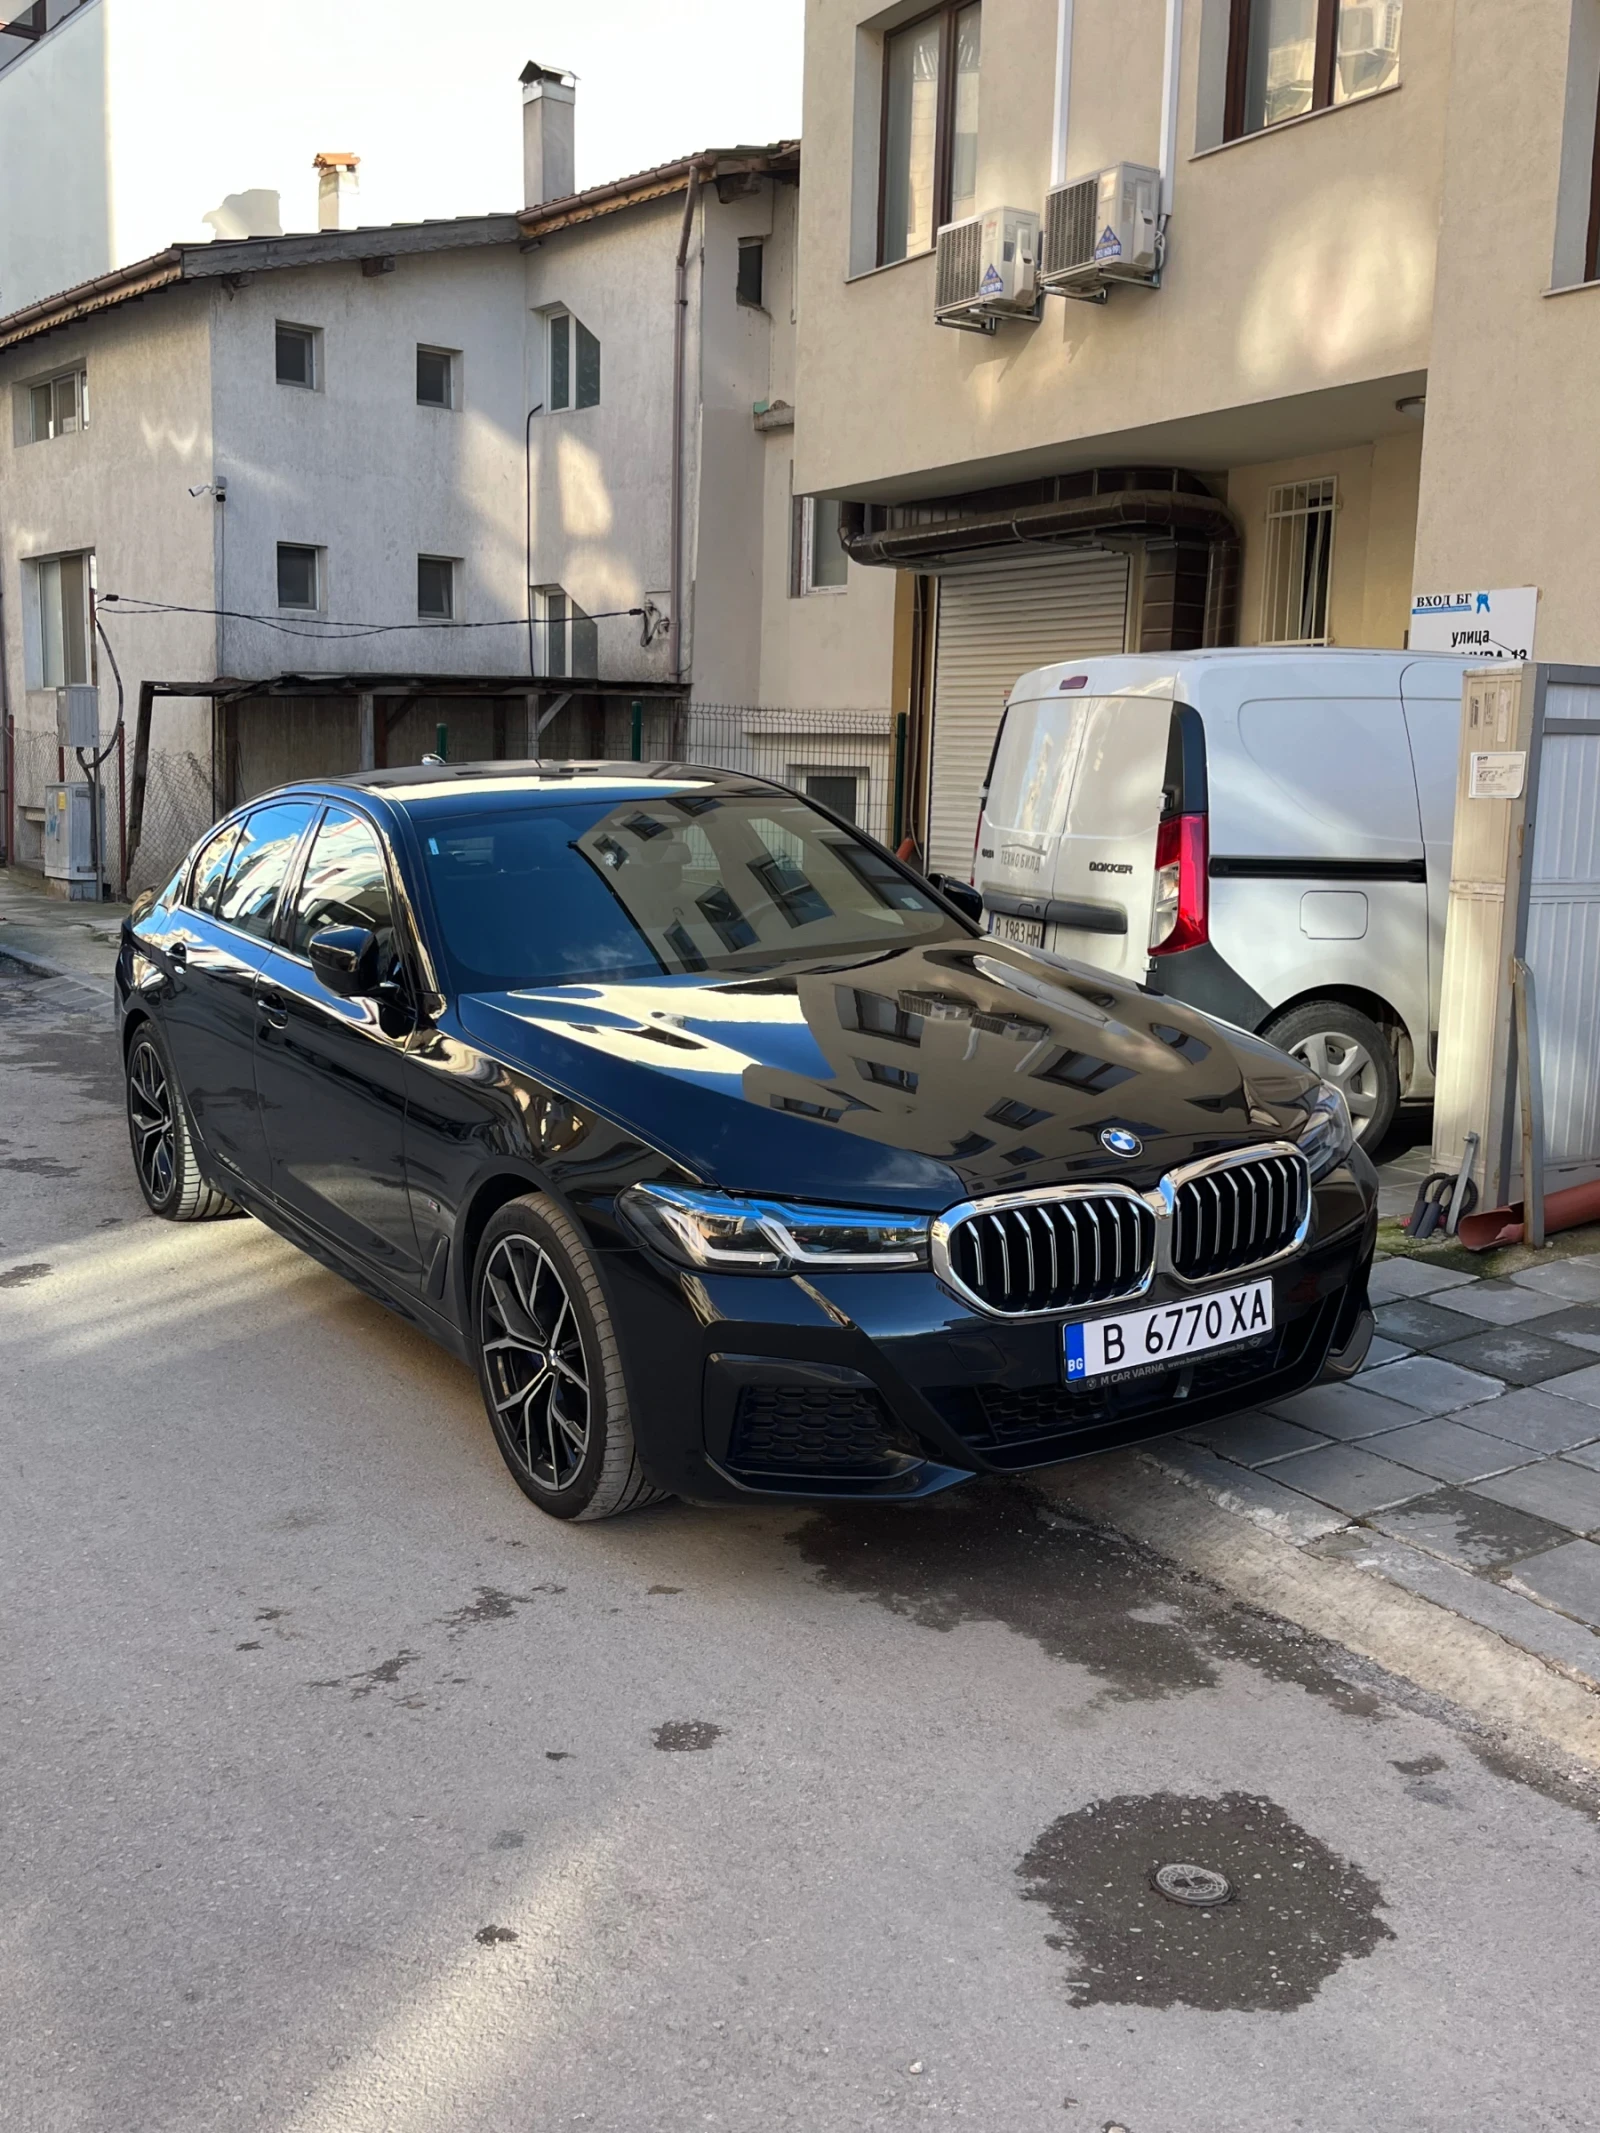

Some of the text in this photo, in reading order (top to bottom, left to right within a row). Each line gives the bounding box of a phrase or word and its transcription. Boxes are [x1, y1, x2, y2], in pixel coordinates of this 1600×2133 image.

[1416, 593, 1472, 609] ВХОД БГ
[1451, 629, 1490, 648] улица
[1089, 861, 1133, 875] DOKKER
[1005, 918, 1025, 943] 1983
[1025, 924, 1041, 948] HH
[1103, 1288, 1267, 1365] B 6770 XA
[1067, 1357, 1083, 1372] BG
[1100, 1375, 1109, 1386] M
[1110, 1371, 1131, 1383] CAR
[1131, 1362, 1165, 1378] VARNA
